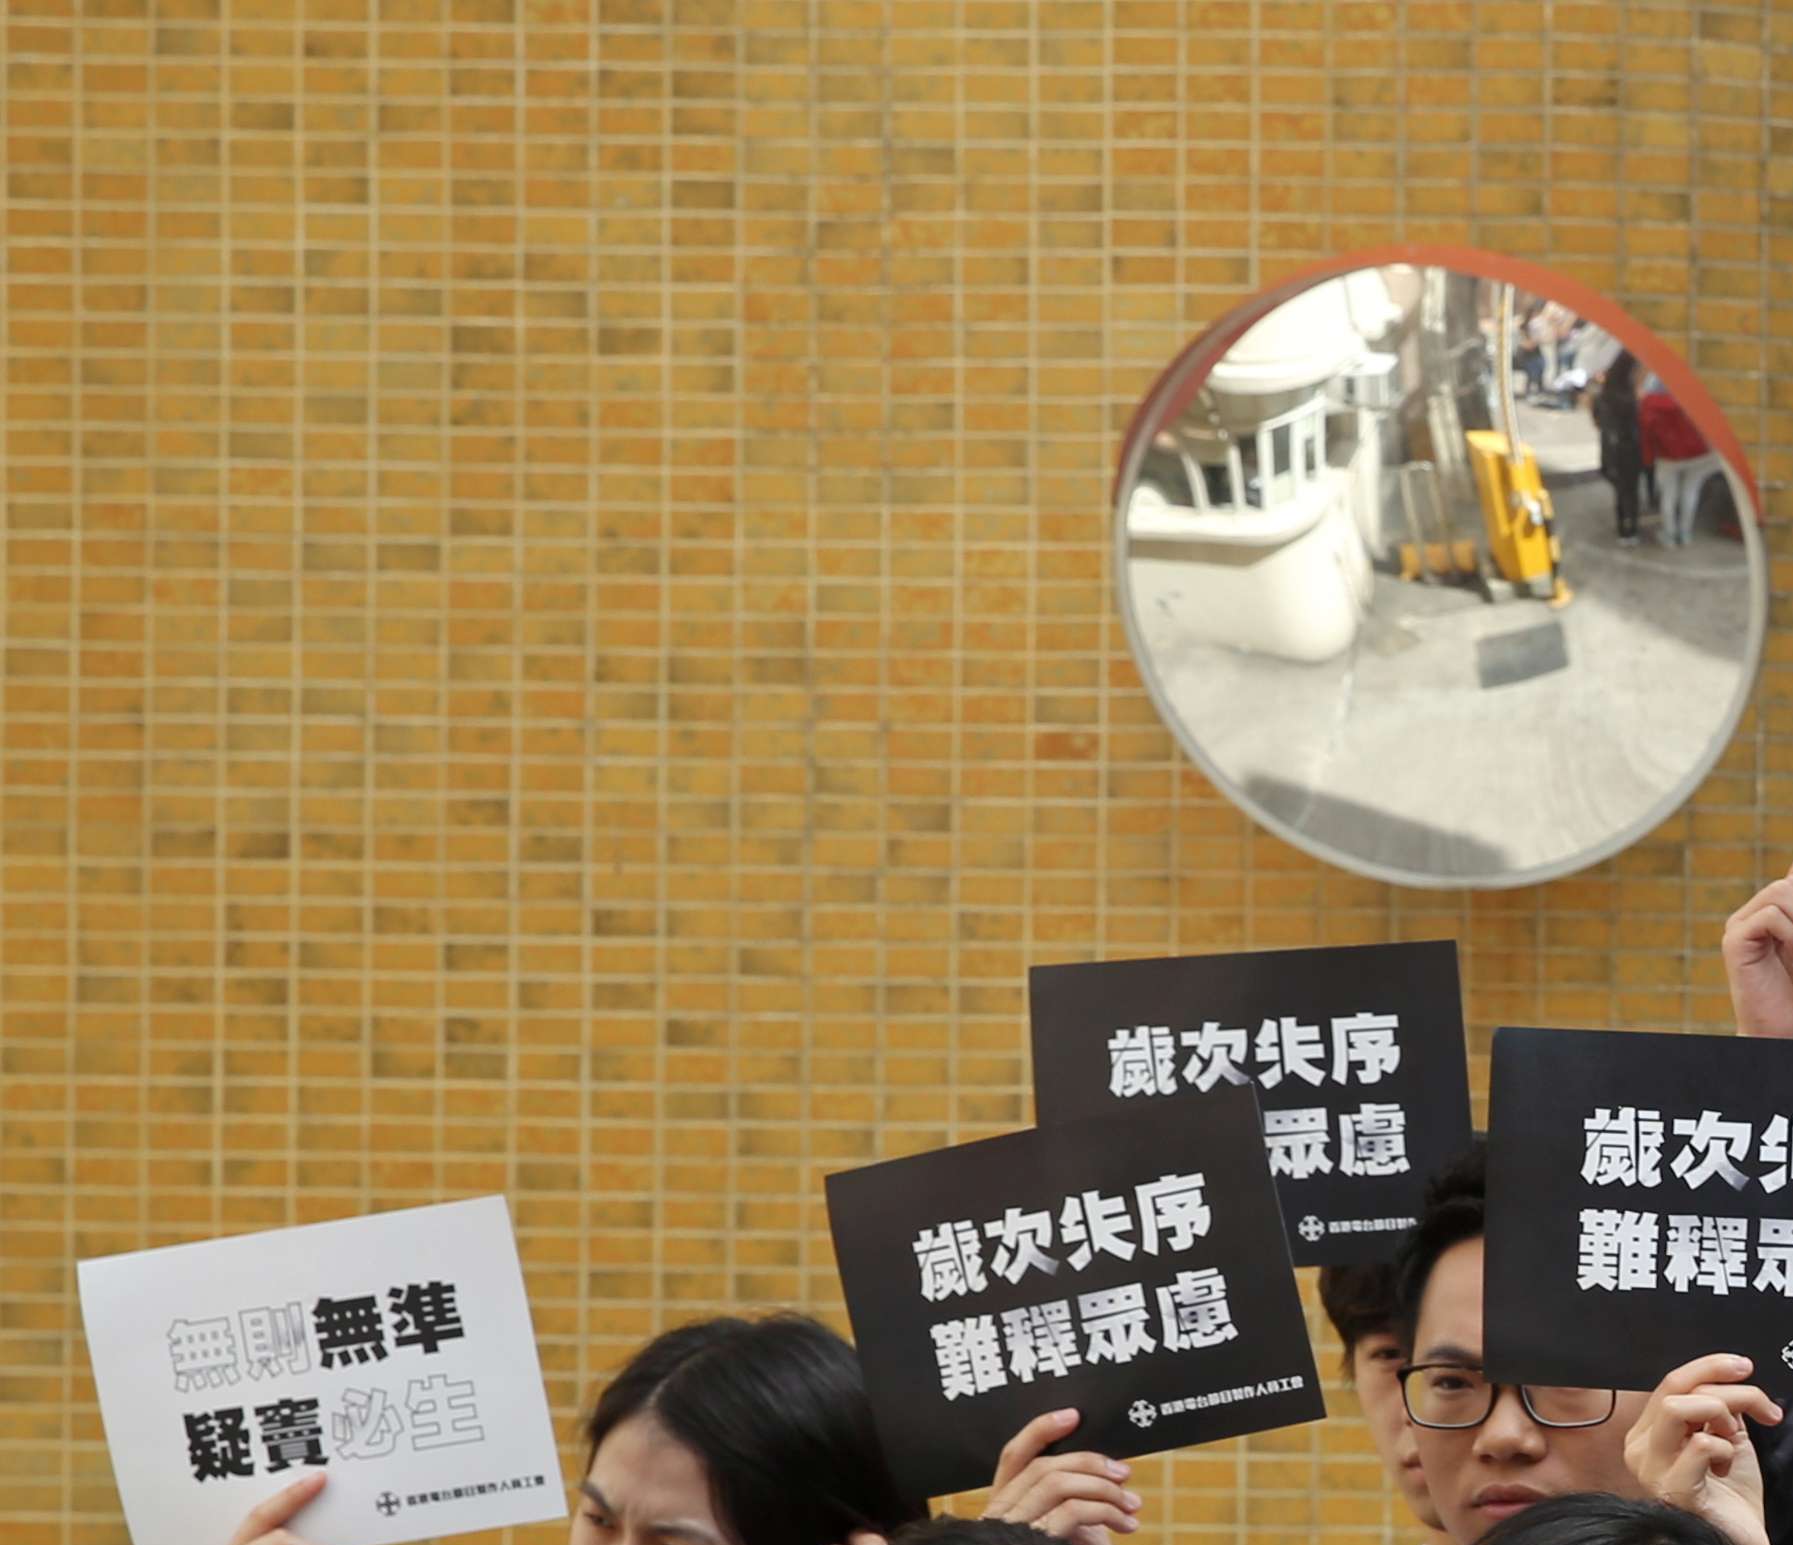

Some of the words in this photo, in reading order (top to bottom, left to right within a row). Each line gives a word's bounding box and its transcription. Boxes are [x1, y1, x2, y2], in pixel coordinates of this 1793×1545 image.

[1107, 1012, 1401, 1097] 歲次失序
[1264, 1103, 1411, 1179] 眾慮
[912, 1172, 1213, 1302] 歲次失序
[166, 1280, 465, 1393] 無則無準
[929, 1267, 1239, 1401] 難釋眾慮
[182, 1374, 485, 1482] 疑竇必生
